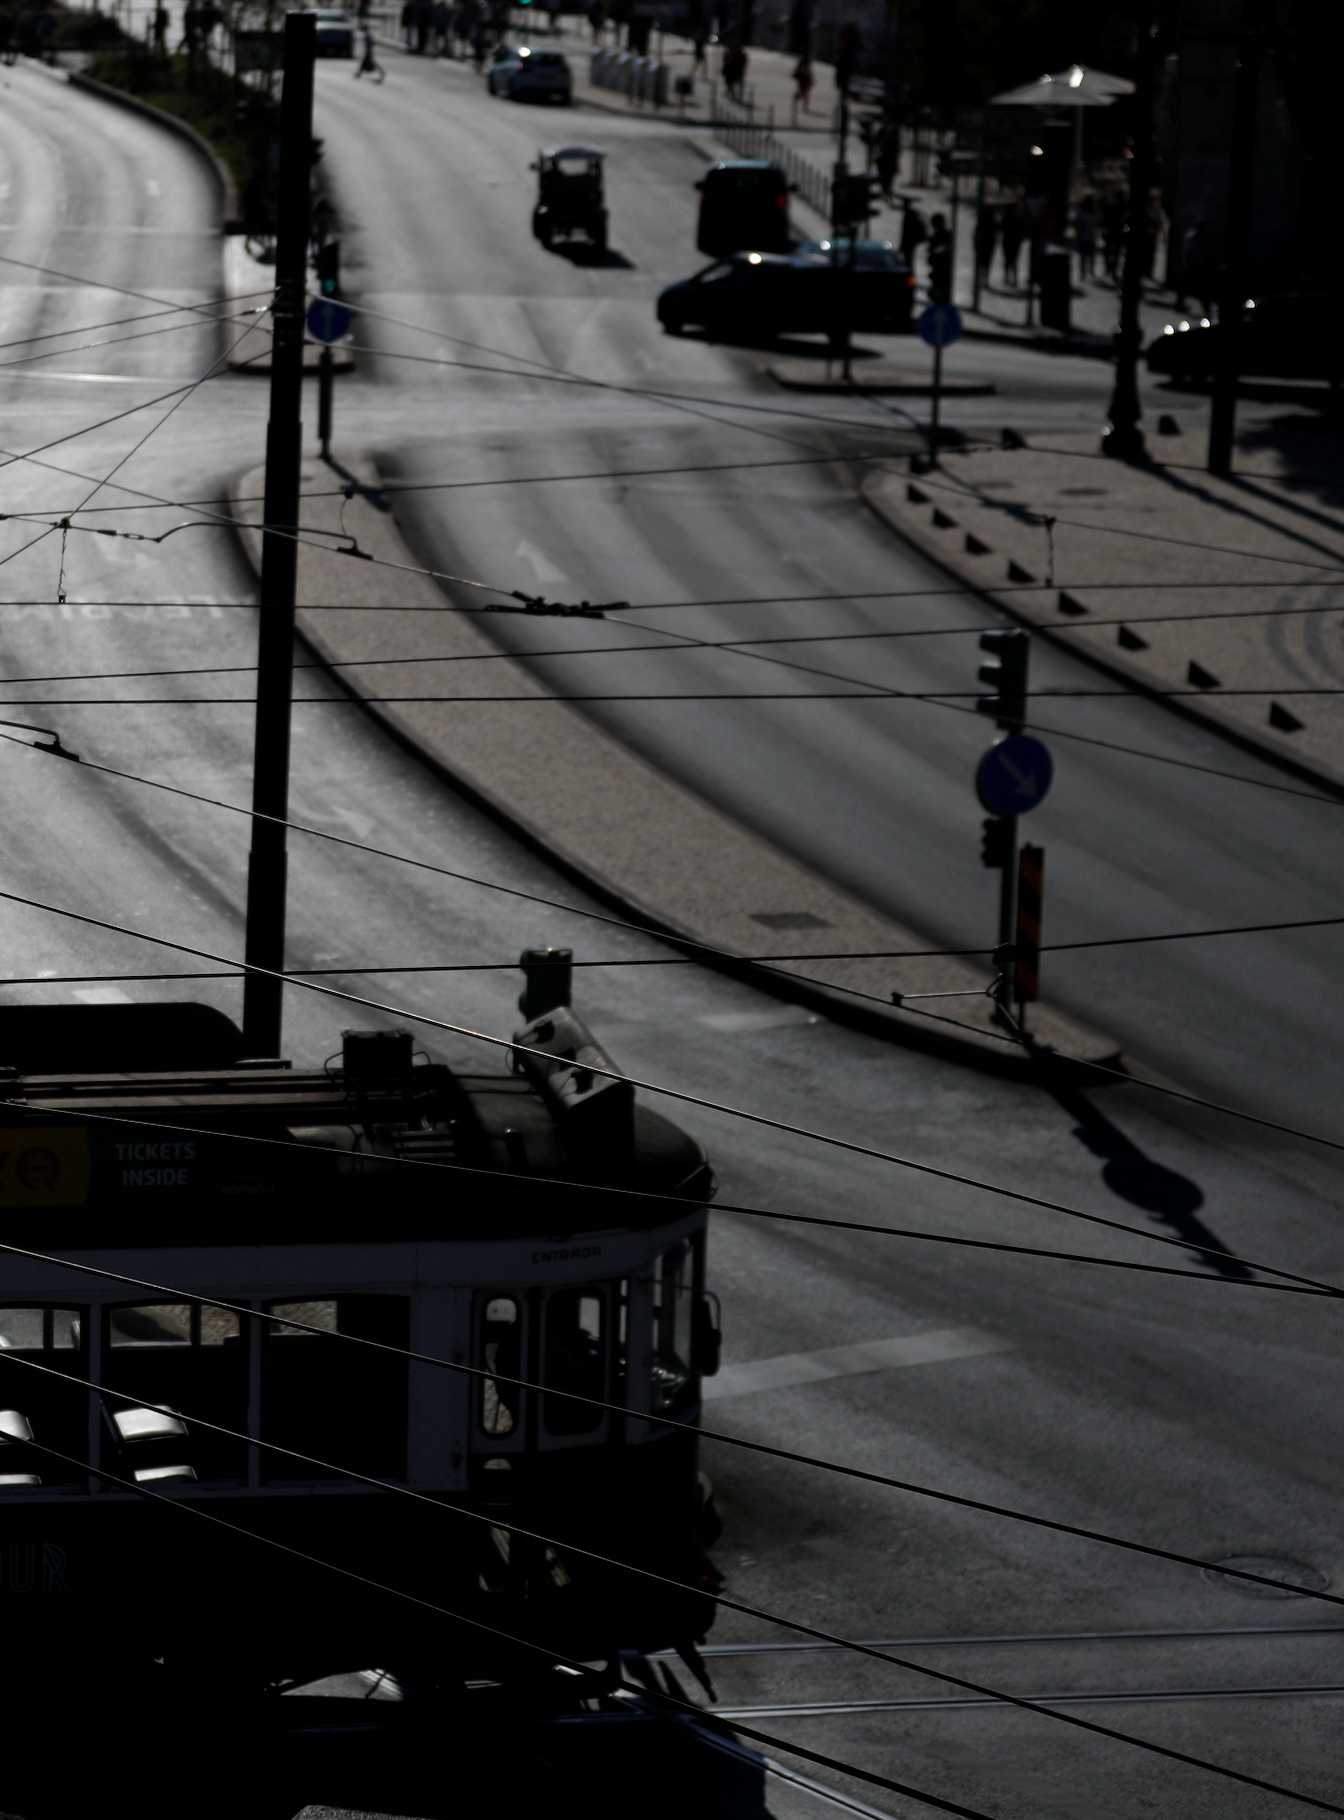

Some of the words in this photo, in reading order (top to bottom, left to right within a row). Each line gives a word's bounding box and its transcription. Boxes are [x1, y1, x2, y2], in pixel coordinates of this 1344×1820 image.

[115, 1142, 197, 1161] TICKETS
[122, 1168, 189, 1187] INSIDE
[532, 1245, 602, 1264] ENTRADA
